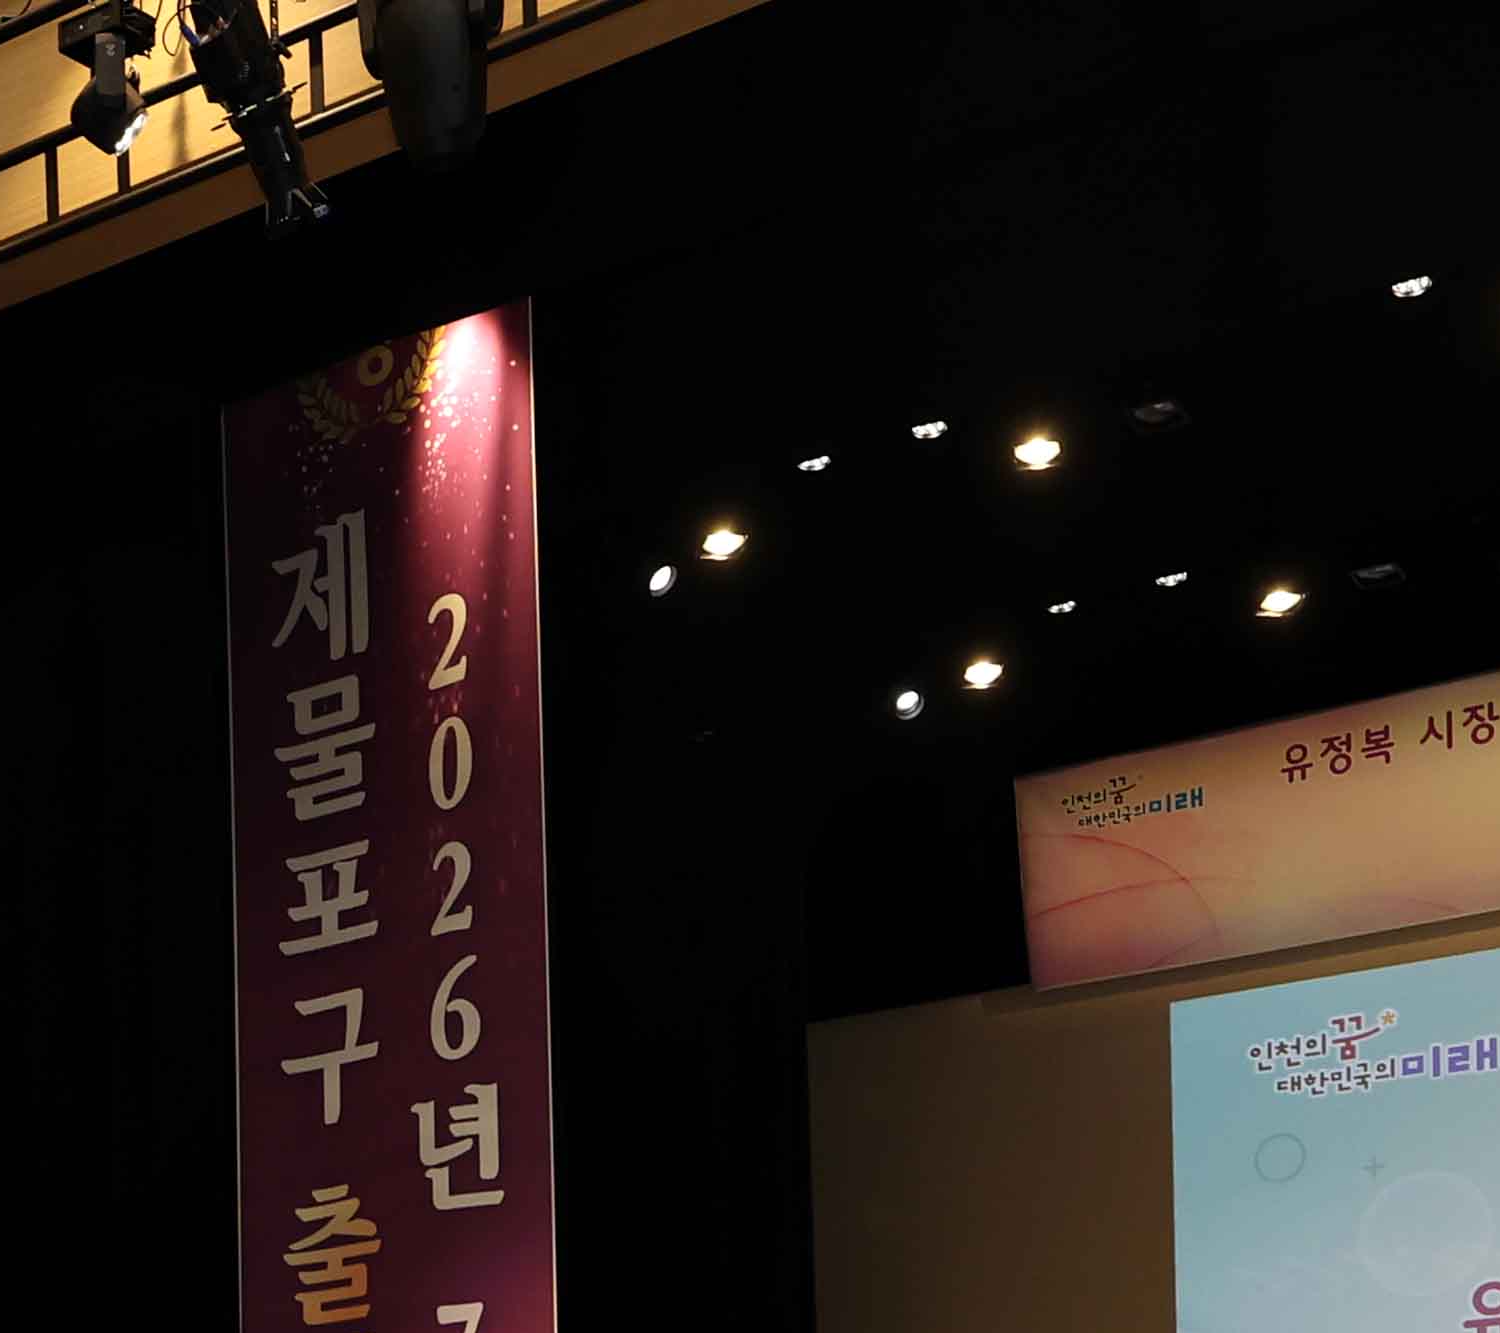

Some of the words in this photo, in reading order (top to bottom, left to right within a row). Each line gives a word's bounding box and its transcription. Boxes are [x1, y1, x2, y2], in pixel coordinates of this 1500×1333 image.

[272, 508, 380, 1126] 제물포구
[412, 593, 504, 1210] 2026년
[1280, 723, 1394, 786] 유정복
